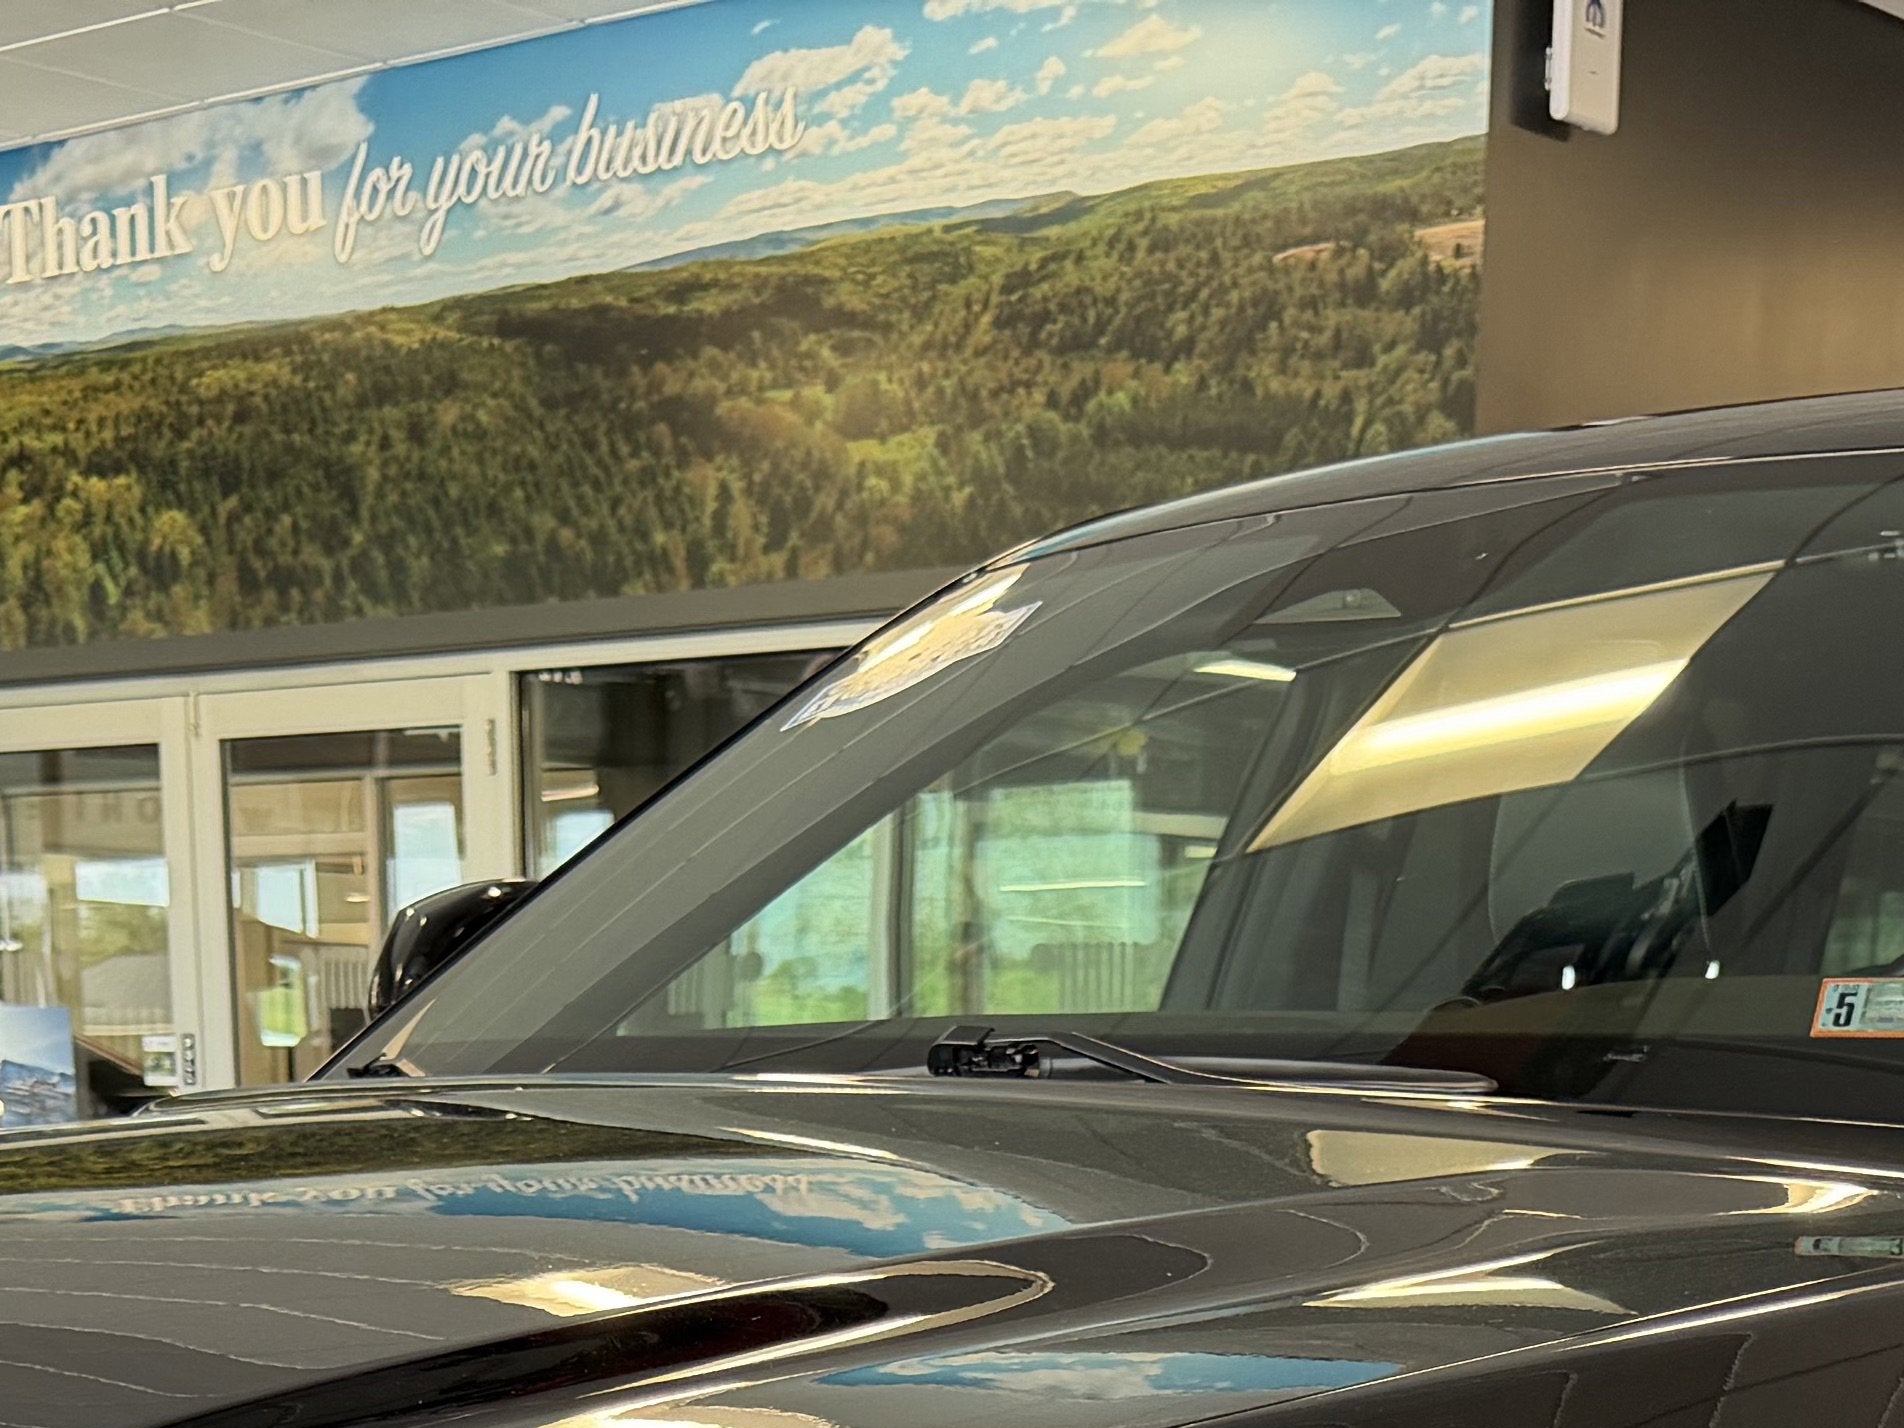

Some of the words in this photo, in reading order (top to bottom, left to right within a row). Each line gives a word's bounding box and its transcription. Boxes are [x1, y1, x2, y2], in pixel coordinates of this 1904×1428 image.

[209, 170, 327, 272] you
[334, 142, 418, 263] for
[419, 133, 557, 257] your
[566, 93, 806, 186] business
[1832, 992, 1859, 1028] 5
